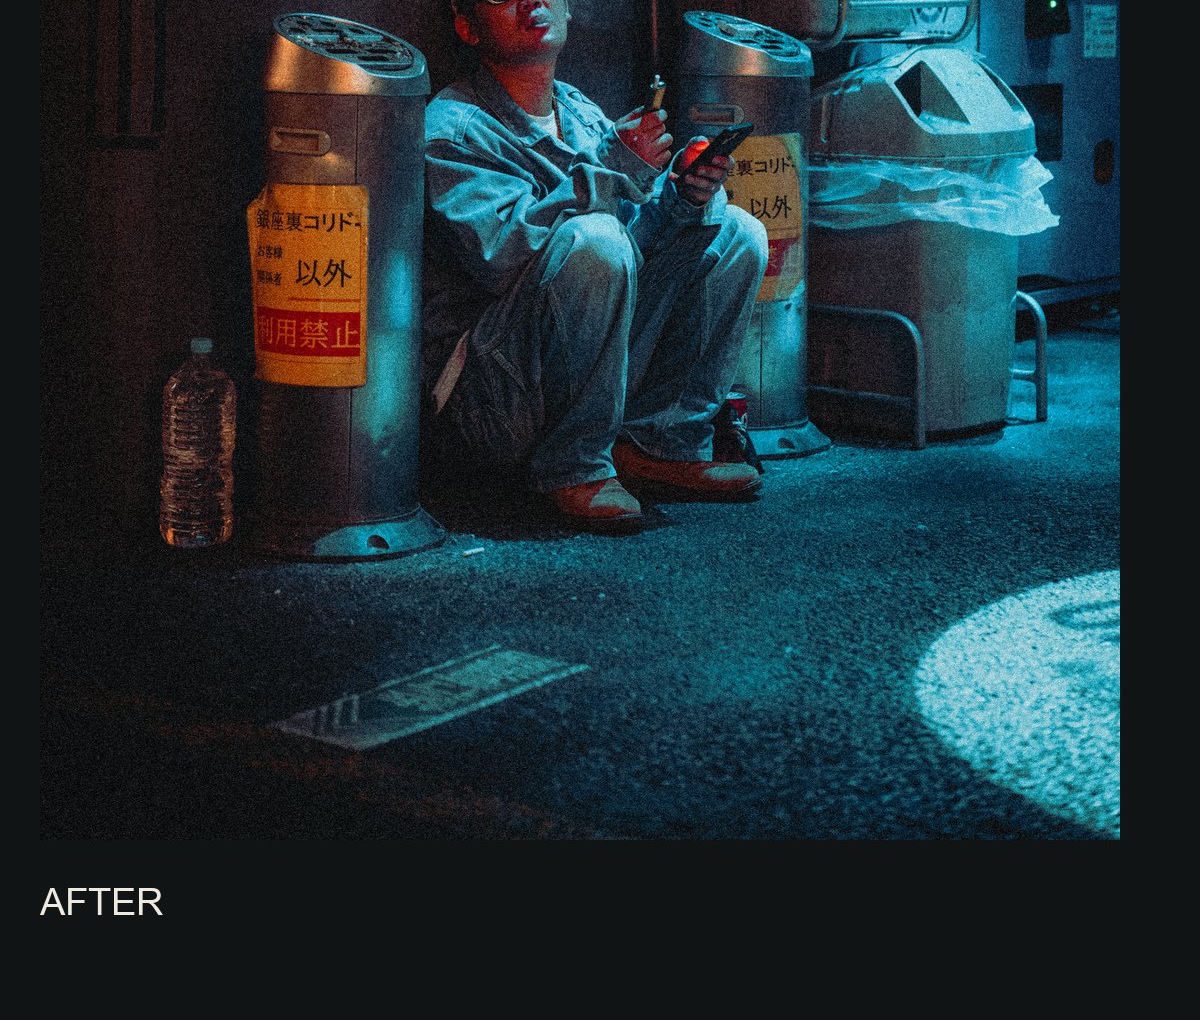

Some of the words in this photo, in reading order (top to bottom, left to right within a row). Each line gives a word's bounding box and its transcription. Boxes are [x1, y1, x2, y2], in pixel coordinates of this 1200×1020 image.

[750, 195, 792, 219] 以外
[296, 259, 352, 287] 以外
[259, 314, 360, 349] 利用禁止
